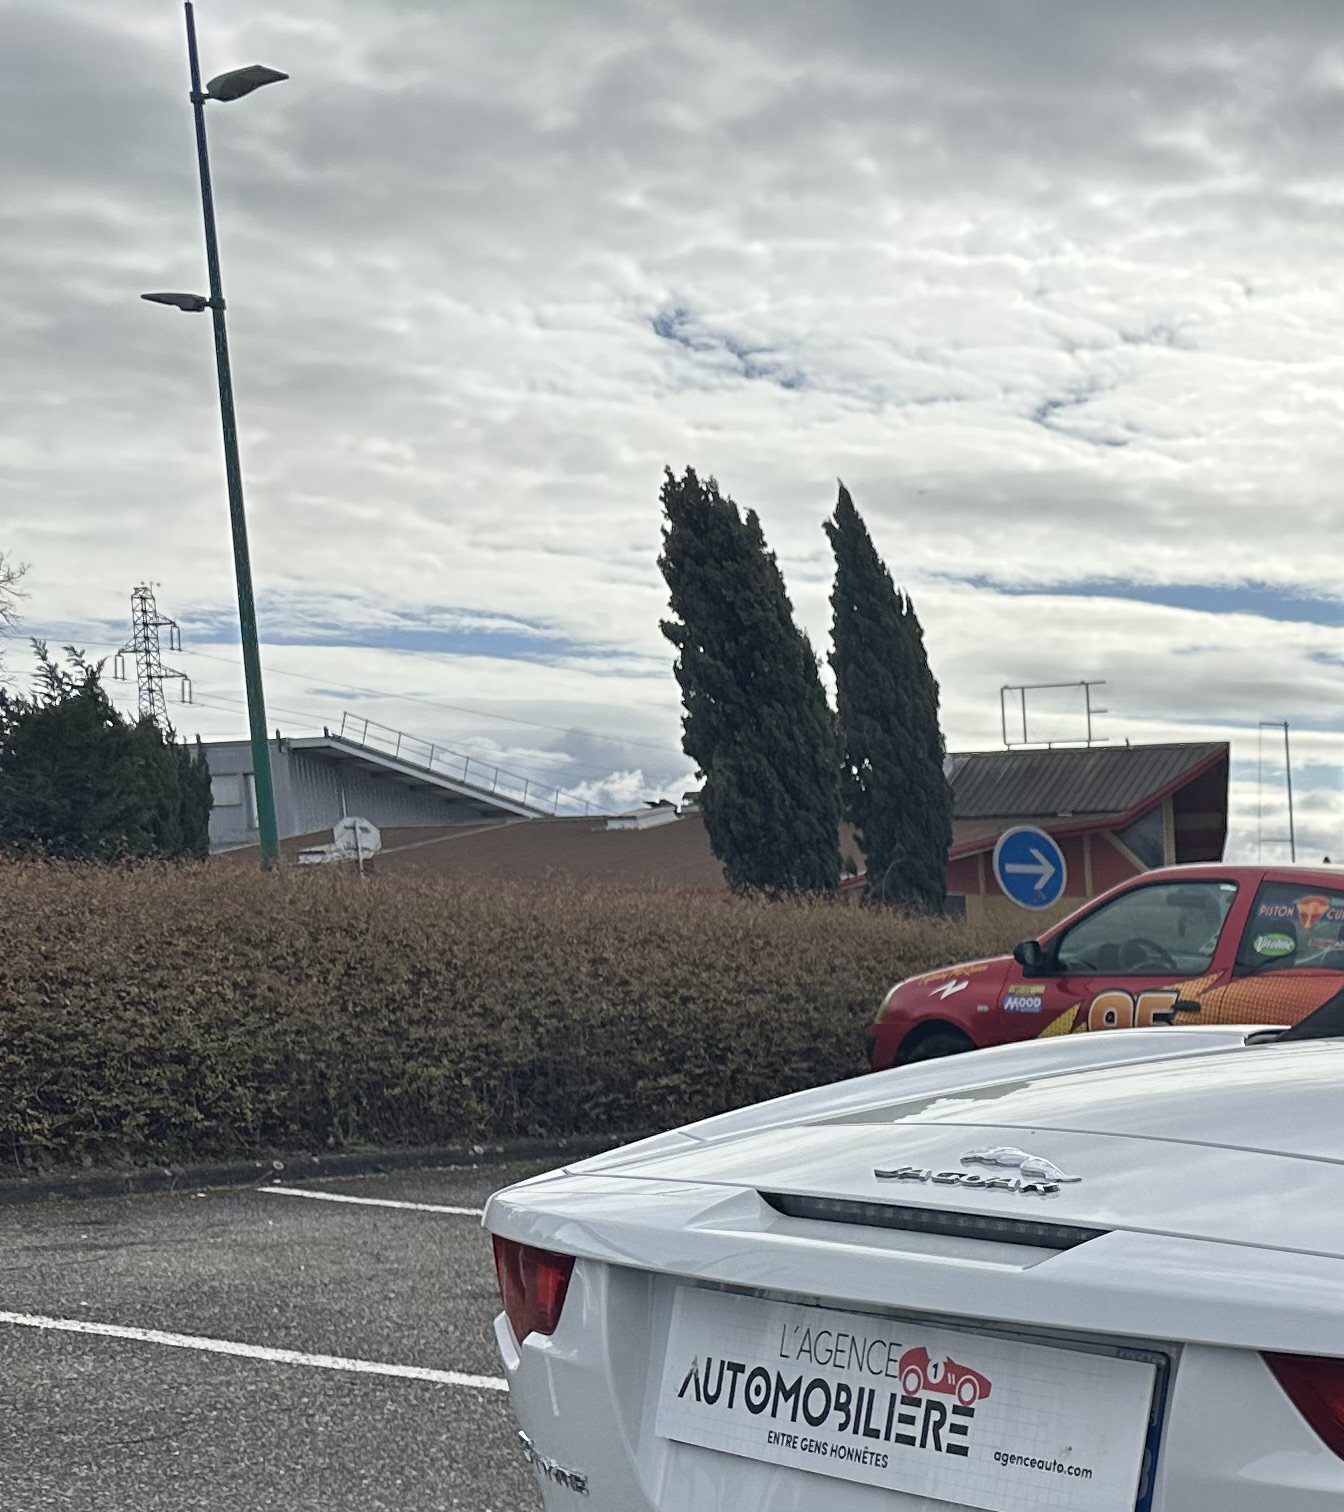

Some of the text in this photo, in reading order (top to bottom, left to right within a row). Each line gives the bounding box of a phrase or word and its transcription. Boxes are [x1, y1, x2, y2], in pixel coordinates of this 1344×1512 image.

[1259, 904, 1295, 917] PISTON
[1004, 996, 1042, 1010] MOOD
[873, 1166, 1061, 1196] JAGUAR
[779, 1323, 903, 1379] L'AGENCE
[767, 1430, 889, 1469] ENTRE GENS HONNÊTES
[993, 1451, 1094, 1480] agenceauto.com
